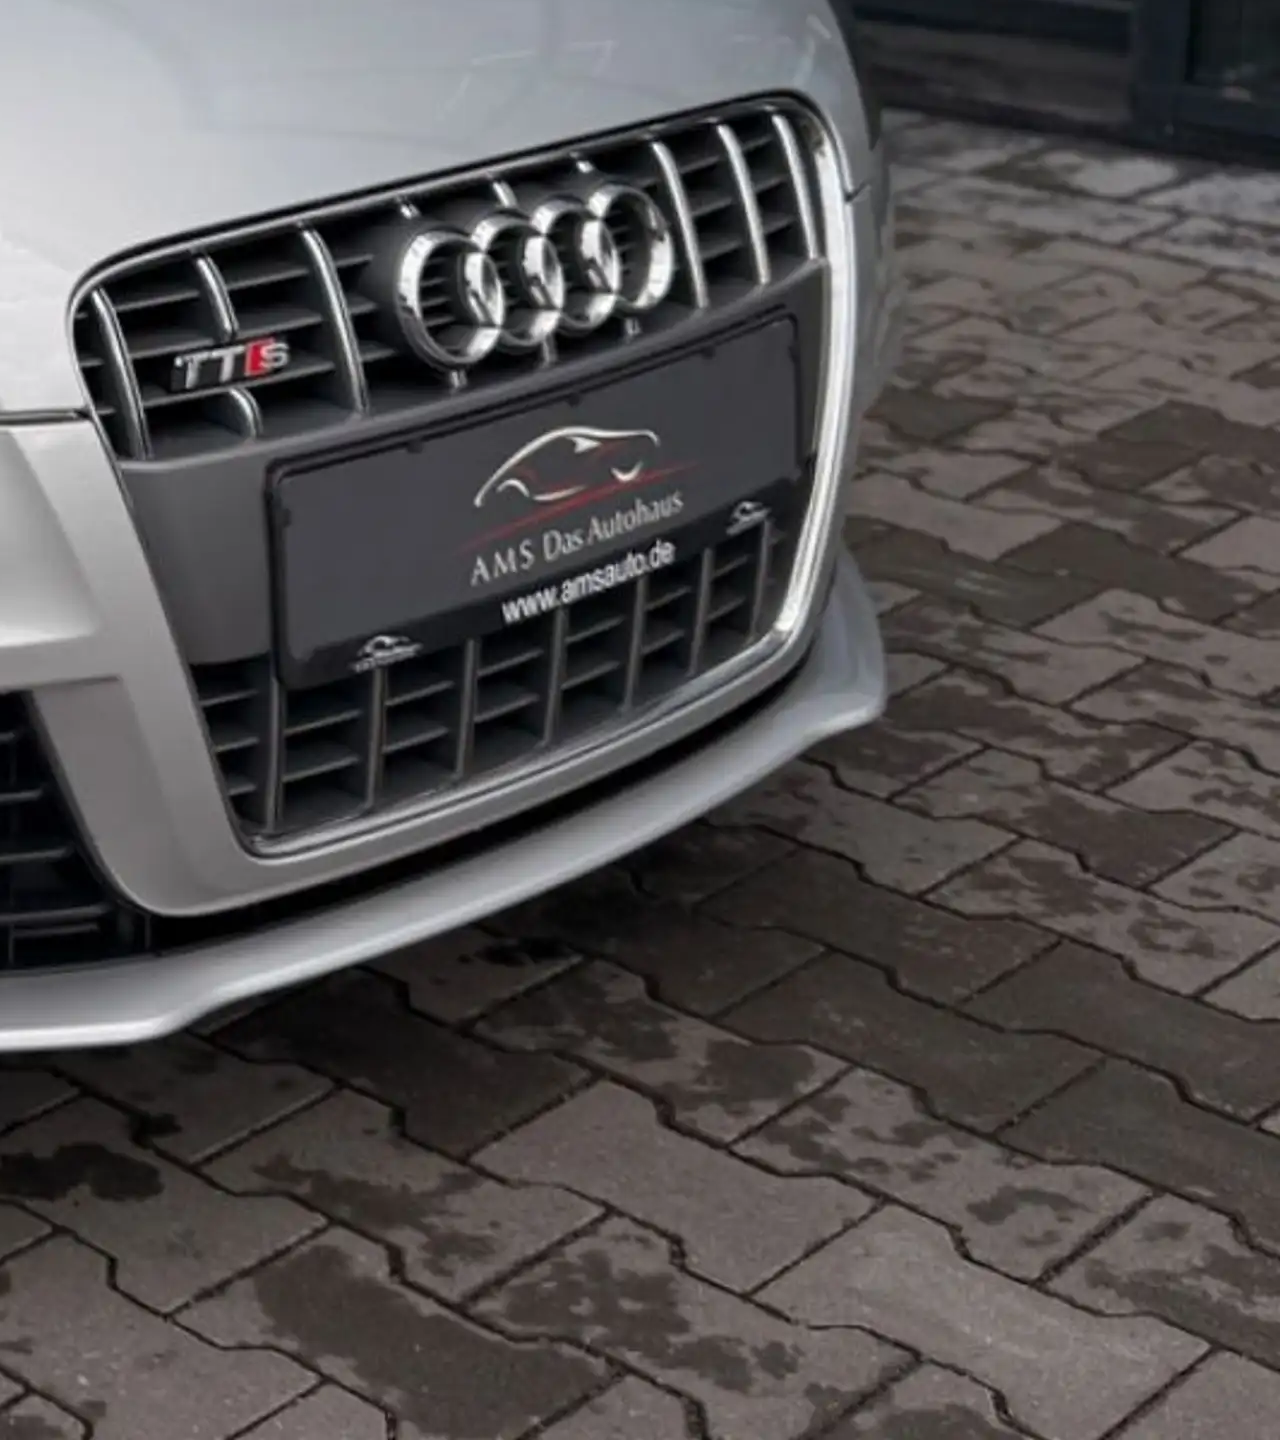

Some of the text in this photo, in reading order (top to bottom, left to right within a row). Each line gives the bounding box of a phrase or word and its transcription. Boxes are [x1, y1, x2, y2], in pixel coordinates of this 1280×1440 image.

[174, 342, 289, 390] TTS
[470, 538, 536, 587] AMS
[543, 528, 584, 561] Das
[586, 490, 685, 544] Autohaus
[501, 539, 676, 624] www.amsauto.de
